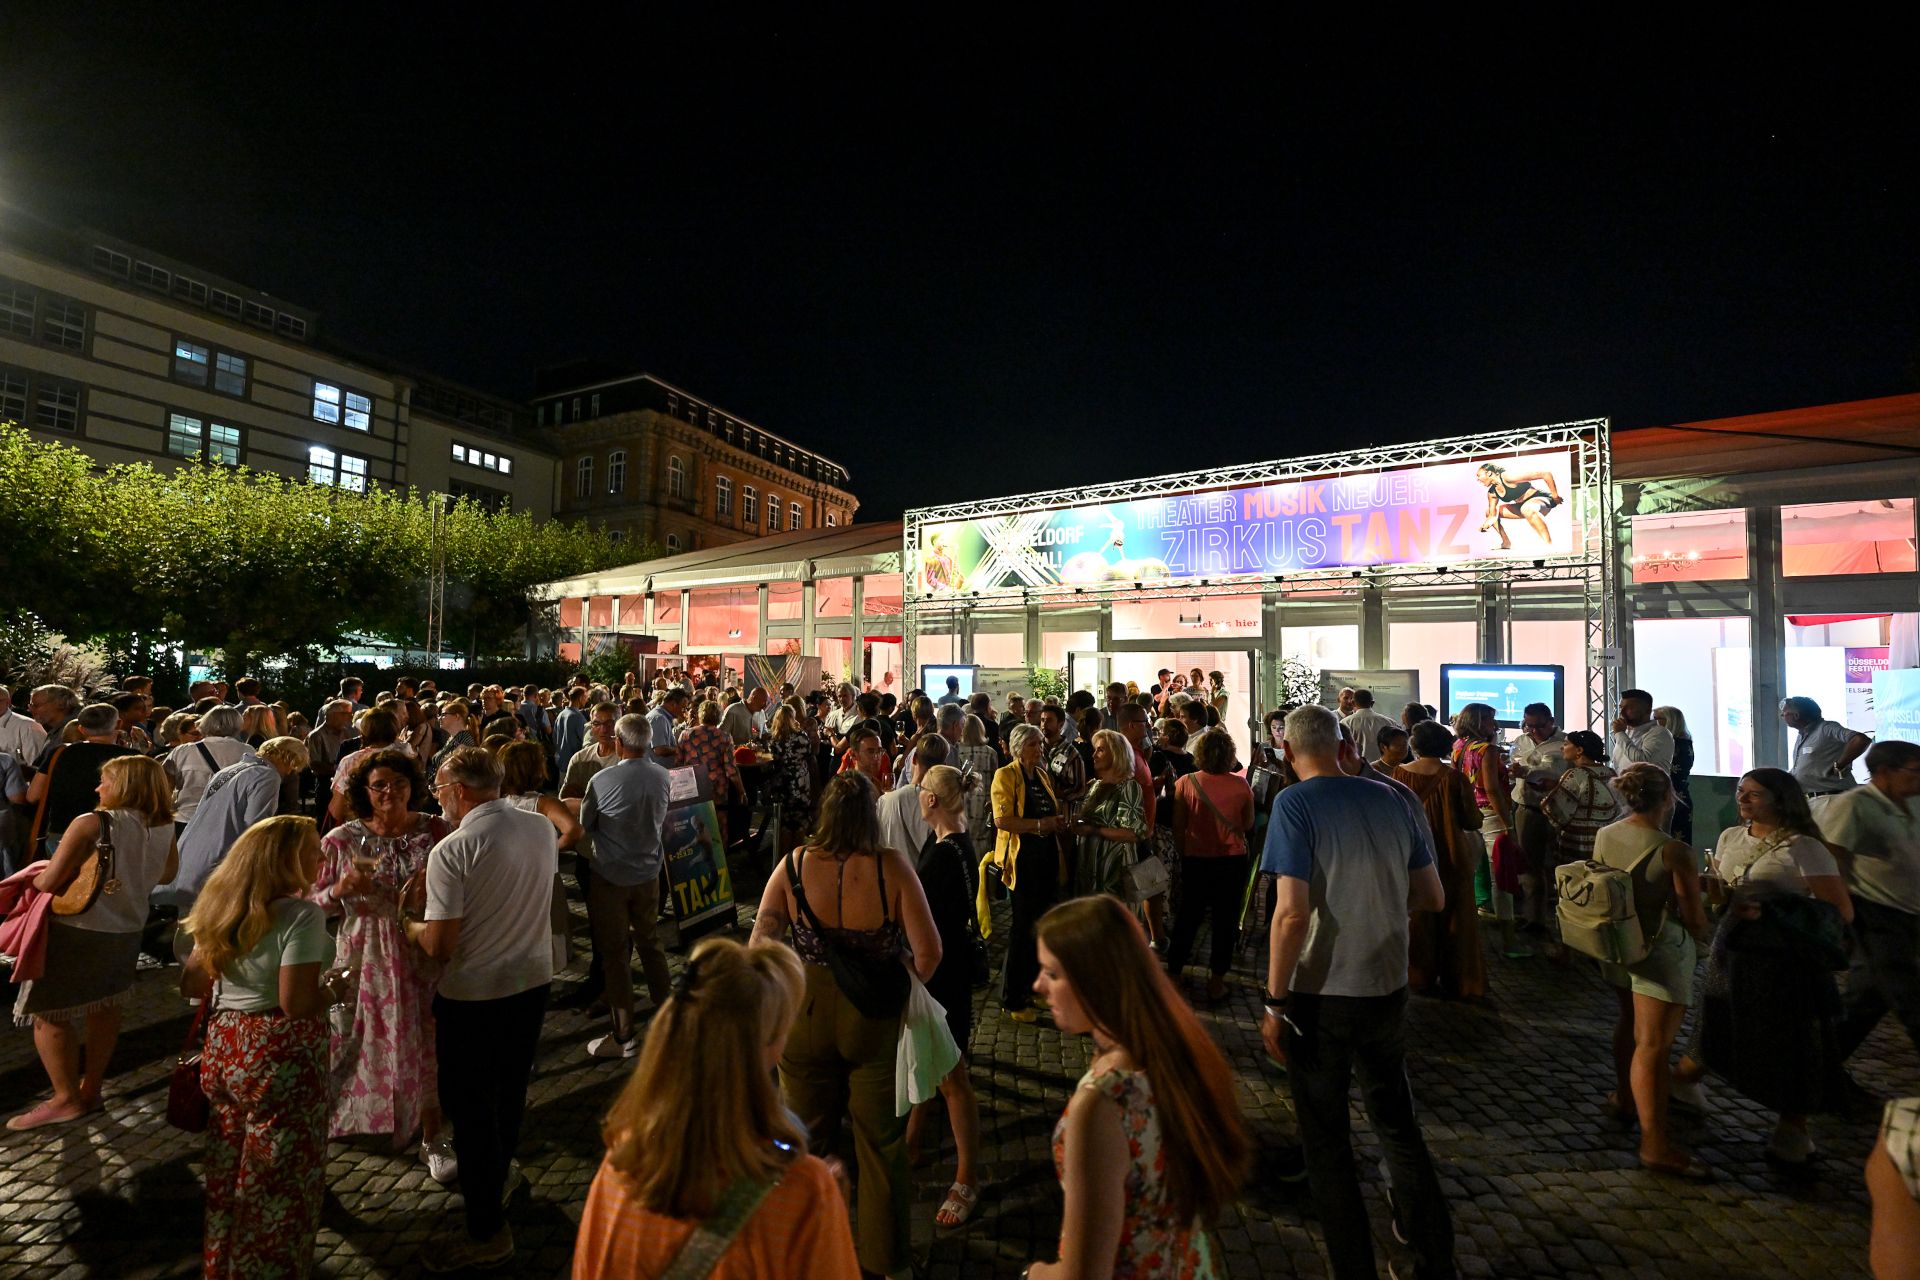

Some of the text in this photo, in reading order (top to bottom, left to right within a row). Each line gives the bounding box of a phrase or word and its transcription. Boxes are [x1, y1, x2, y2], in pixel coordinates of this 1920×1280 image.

[1135, 474, 1430, 530] THEATER MUSIK NEUER
[1161, 504, 1470, 573] ZIRKUS TANZ
[1235, 619, 1258, 628] hier
